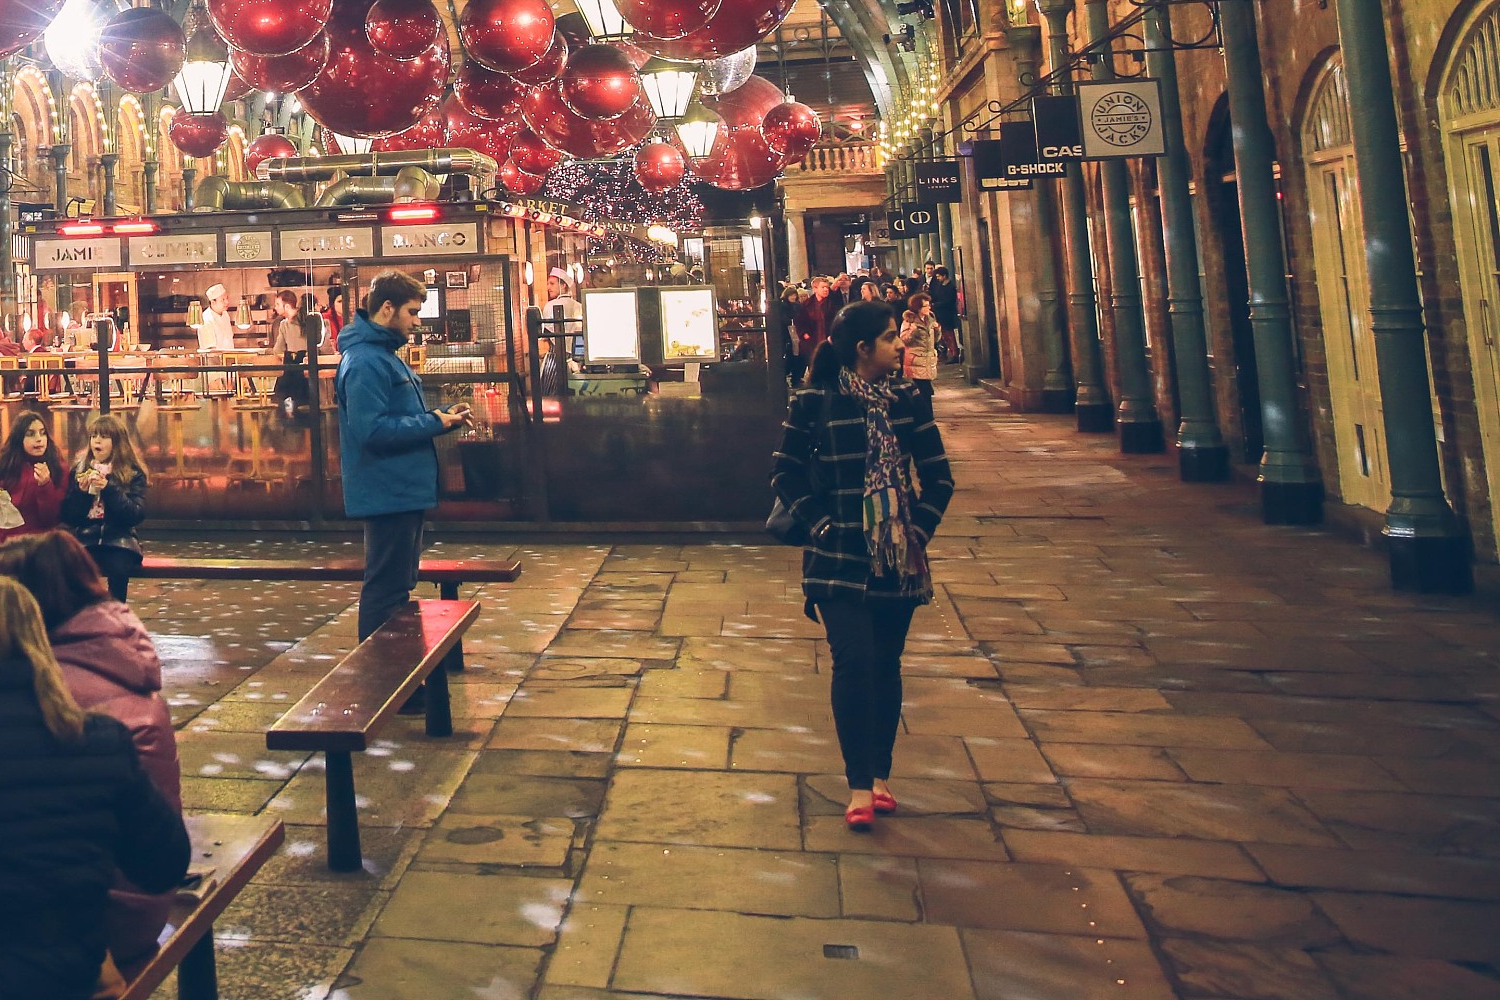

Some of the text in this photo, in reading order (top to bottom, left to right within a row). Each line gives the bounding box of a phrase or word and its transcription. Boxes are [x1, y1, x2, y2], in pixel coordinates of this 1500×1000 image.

[1096, 94, 1144, 114] UNION
[1104, 115, 1139, 123] JAMIE'S
[1097, 124, 1146, 144] JACKS
[1042, 145, 1083, 158] CAS
[1007, 162, 1064, 175] G-SHOCK
[918, 176, 958, 185] LINKS
[517, 199, 569, 215] ARKET
